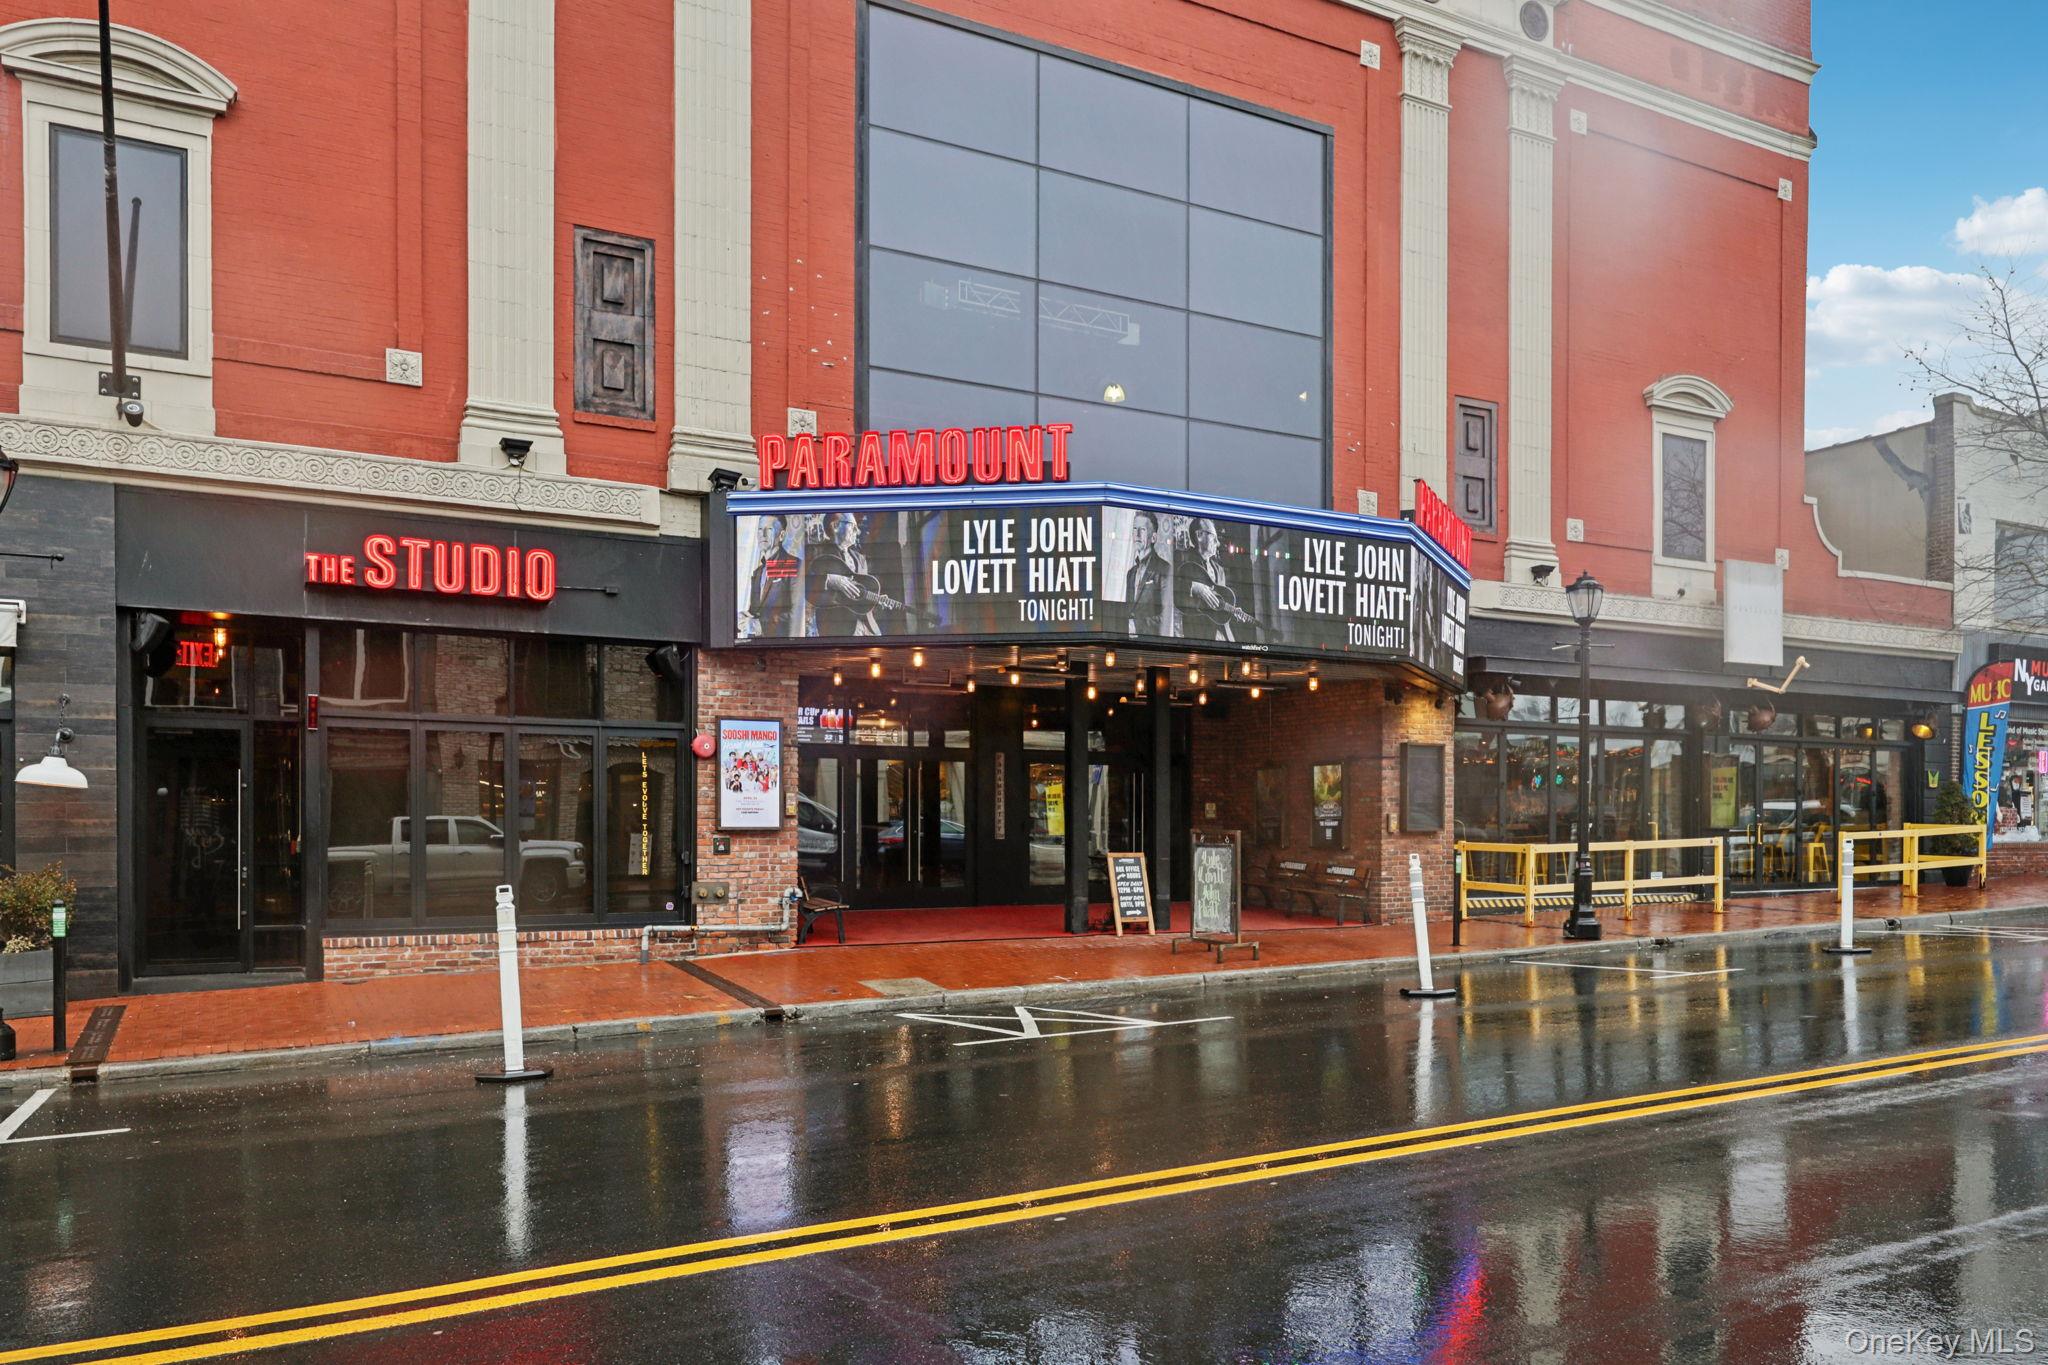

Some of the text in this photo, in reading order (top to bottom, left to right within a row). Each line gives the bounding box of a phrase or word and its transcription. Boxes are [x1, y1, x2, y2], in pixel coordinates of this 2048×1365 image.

[759, 423, 1073, 490] PARAMOUNT
[963, 516, 1093, 555] LYLE JOHN
[305, 534, 556, 600] THE STUDIO
[932, 556, 1096, 595] LOVETT HIATT
[1304, 538, 1404, 583] LYLE JOHN
[1019, 598, 1094, 621] TONIGHT!
[1279, 574, 1406, 621] LOVETT HIATT
[1348, 622, 1404, 649] TONIGHT!
[1970, 678, 2011, 703] MUIC
[2014, 658, 2035, 696] NY
[2033, 679, 2048, 692] GA
[722, 729, 777, 741] SOOSHI MANGO
